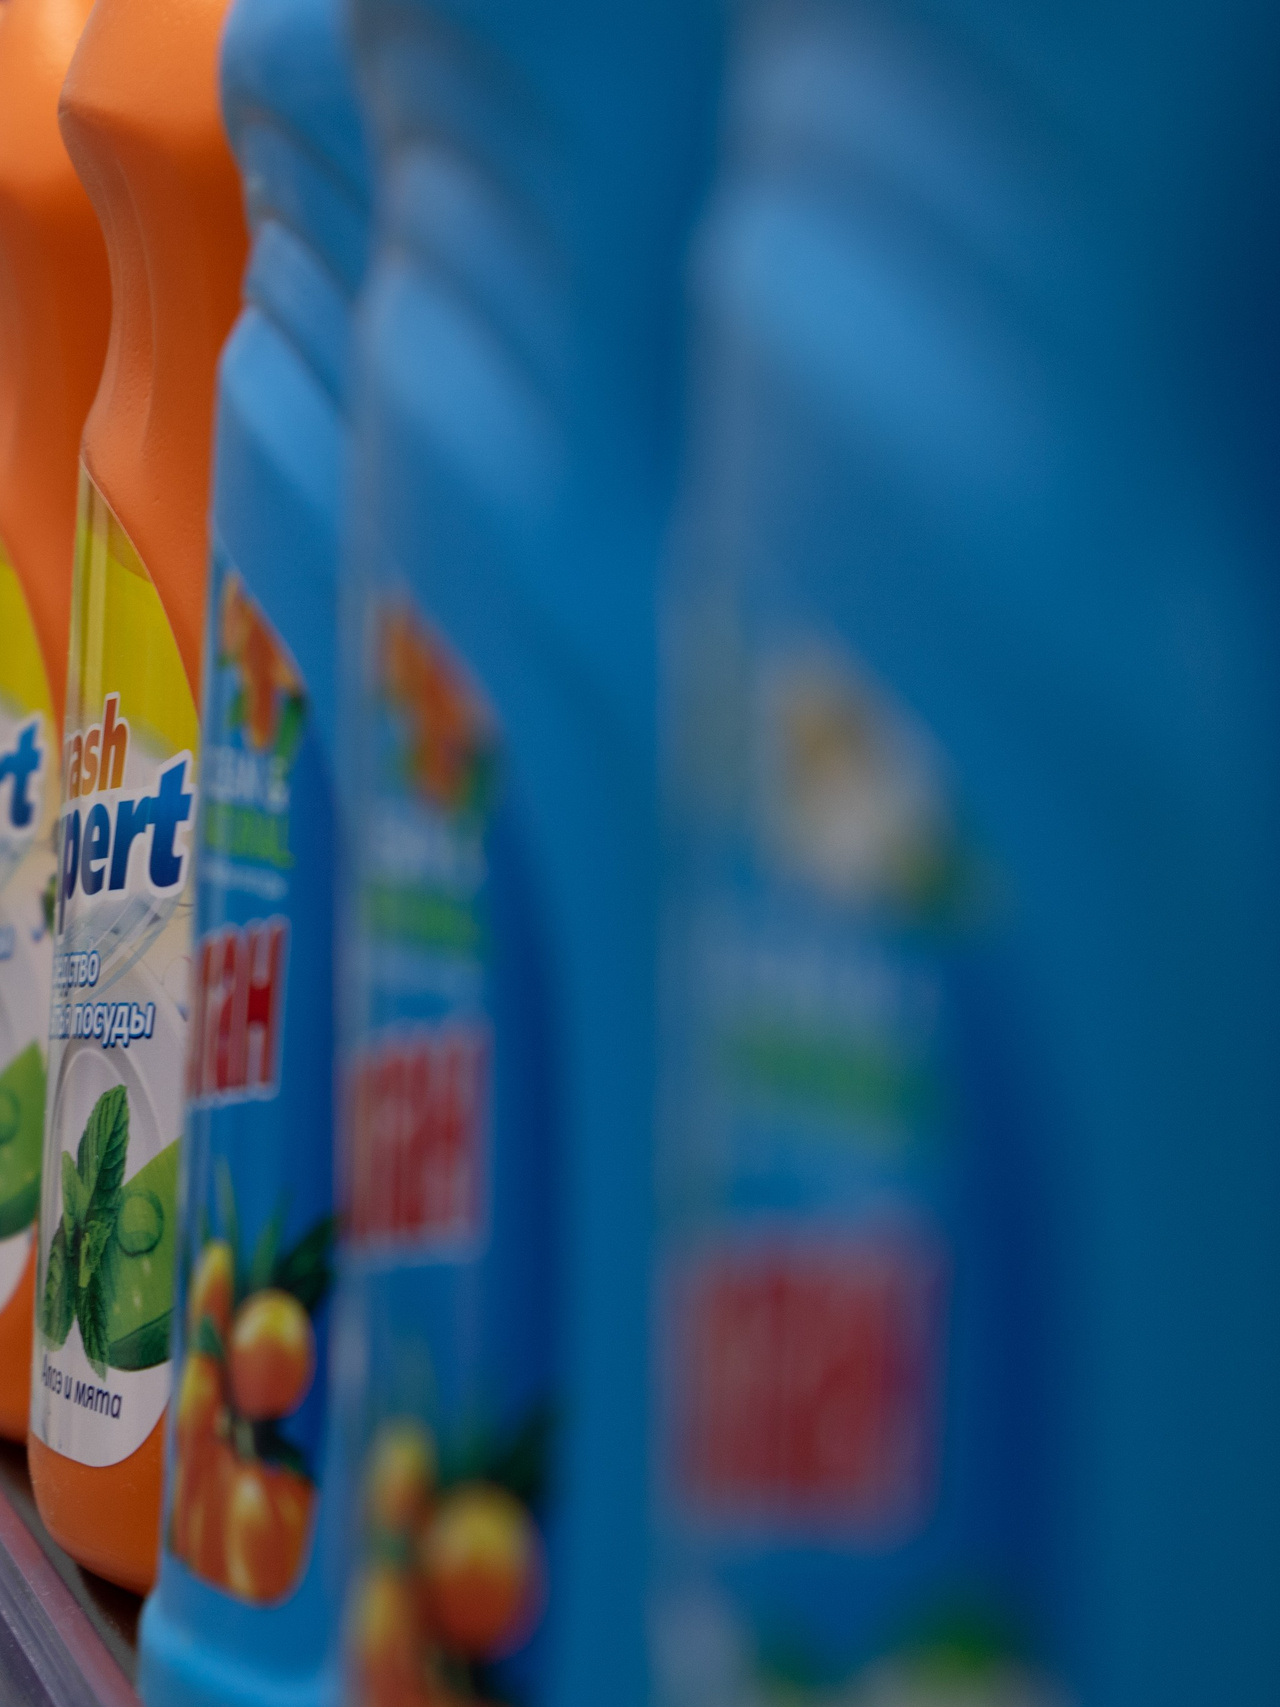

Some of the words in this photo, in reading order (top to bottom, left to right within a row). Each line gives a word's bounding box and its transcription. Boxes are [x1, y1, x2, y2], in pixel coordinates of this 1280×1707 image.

[64, 697, 129, 800] ash
[59, 758, 193, 936] pert
[71, 1002, 157, 1049] посуды
[73, 1380, 122, 1420] мята
